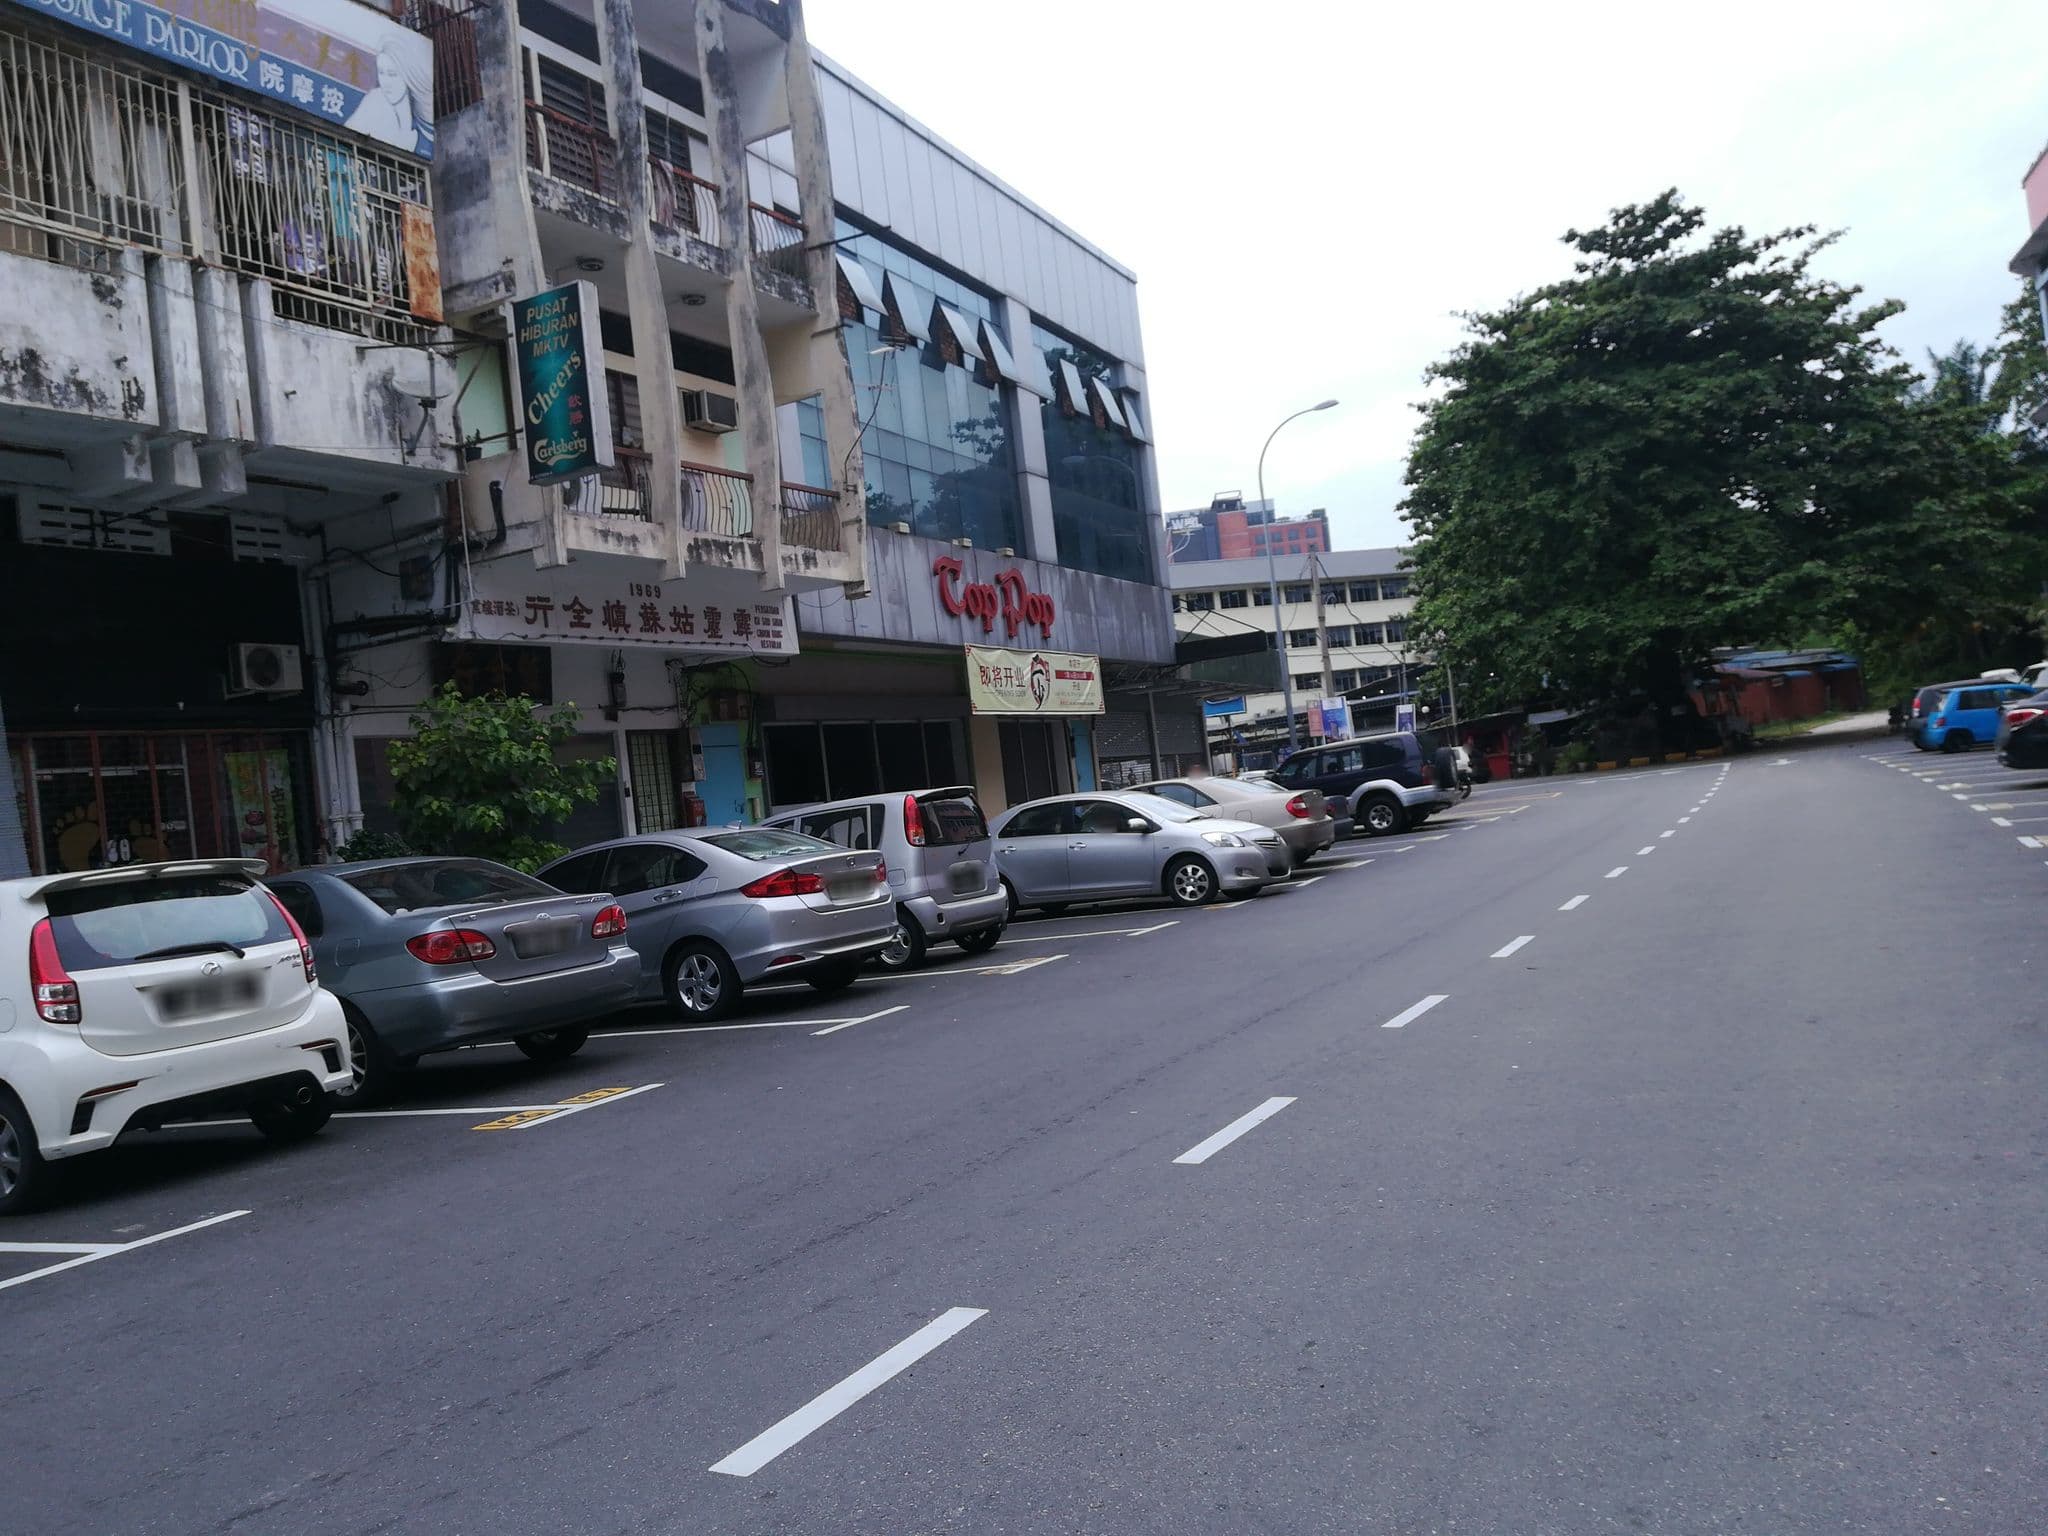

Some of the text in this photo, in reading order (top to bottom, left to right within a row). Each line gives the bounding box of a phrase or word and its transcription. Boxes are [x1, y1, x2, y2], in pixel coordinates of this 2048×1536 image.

[145, 13, 249, 83] PARLOR
[526, 297, 569, 324] PUSAT
[520, 311, 578, 344] HIBURAN
[532, 333, 569, 358] MKTV
[528, 350, 582, 425] Cheers
[533, 437, 588, 464] Carlsberg
[629, 581, 662, 599] 1969
[995, 568, 1056, 639] Pop
[979, 665, 1026, 689] 即将开业
